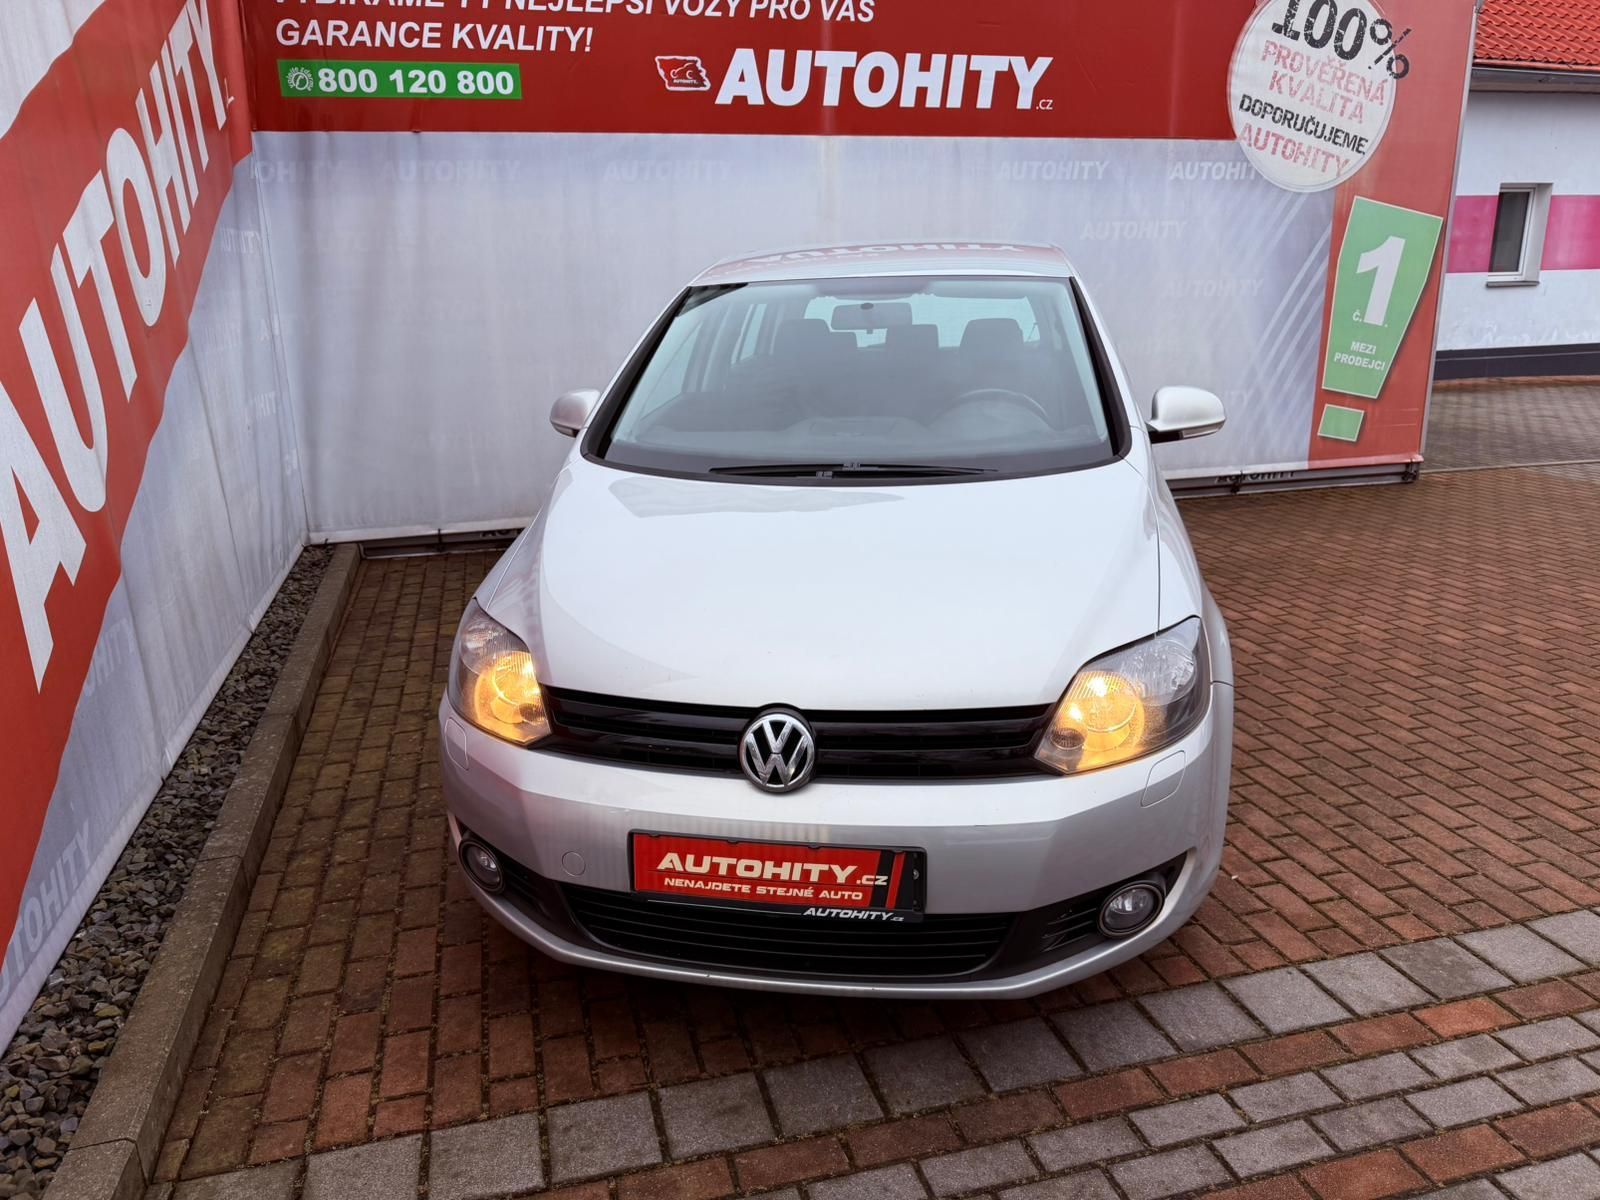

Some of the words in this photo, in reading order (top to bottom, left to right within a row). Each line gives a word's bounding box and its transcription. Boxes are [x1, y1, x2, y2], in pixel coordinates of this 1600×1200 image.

[275, 18, 443, 48] GARANCE
[452, 23, 594, 52] KVALITY!
[1272, 0, 1412, 80] 100%
[318, 68, 377, 93] 800
[389, 69, 446, 94] 120
[457, 71, 514, 95] 800
[1268, 70, 1364, 124] KVALITA
[1239, 94, 1369, 156] DOPORUČUJEME
[1239, 123, 1350, 178] AUTOHITY
[998, 160, 1110, 181] AUTOHITY
[1081, 221, 1188, 240] AUTOHITY
[1350, 340, 1377, 356] MEZI
[1334, 353, 1386, 371] PRODEJCI
[664, 876, 750, 894] NENAJDETE
[756, 885, 814, 899] STEJNÉ
[819, 889, 863, 900] AUTO
